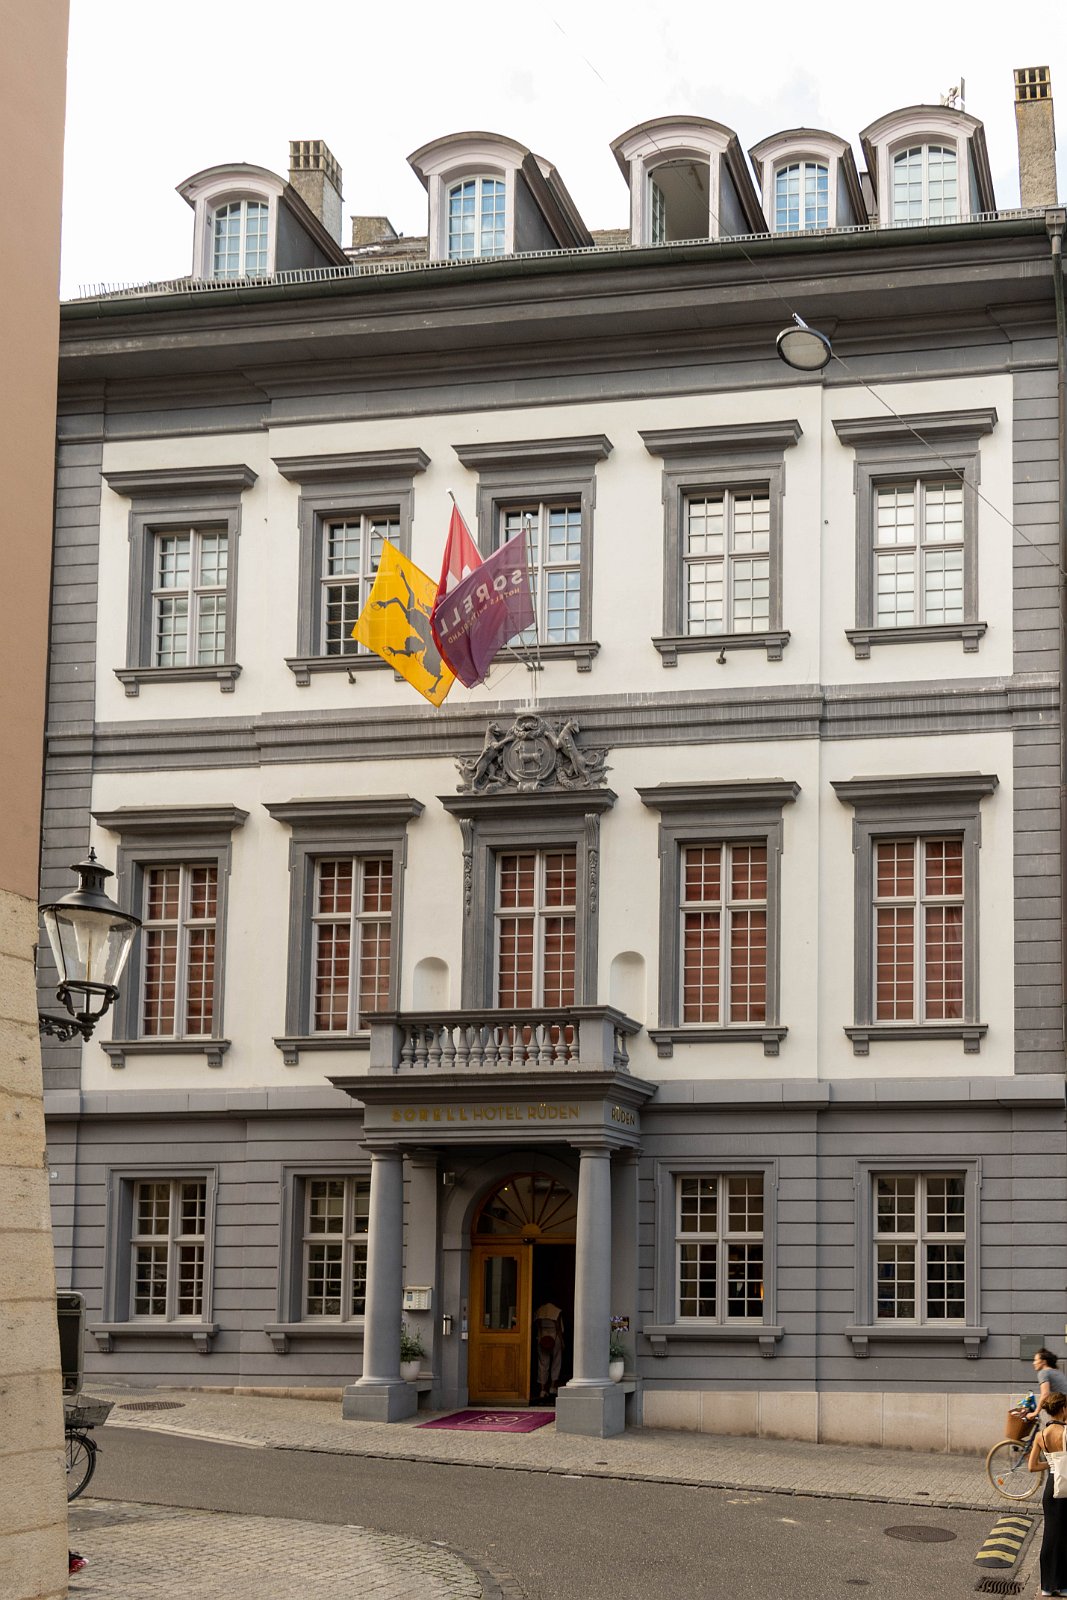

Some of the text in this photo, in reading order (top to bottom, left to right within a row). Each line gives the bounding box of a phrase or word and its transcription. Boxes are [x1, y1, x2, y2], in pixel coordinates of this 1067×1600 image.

[392, 1103, 580, 1123] SORELL HOTEL RÜDEN
[611, 1105, 635, 1125] RÜDEN
